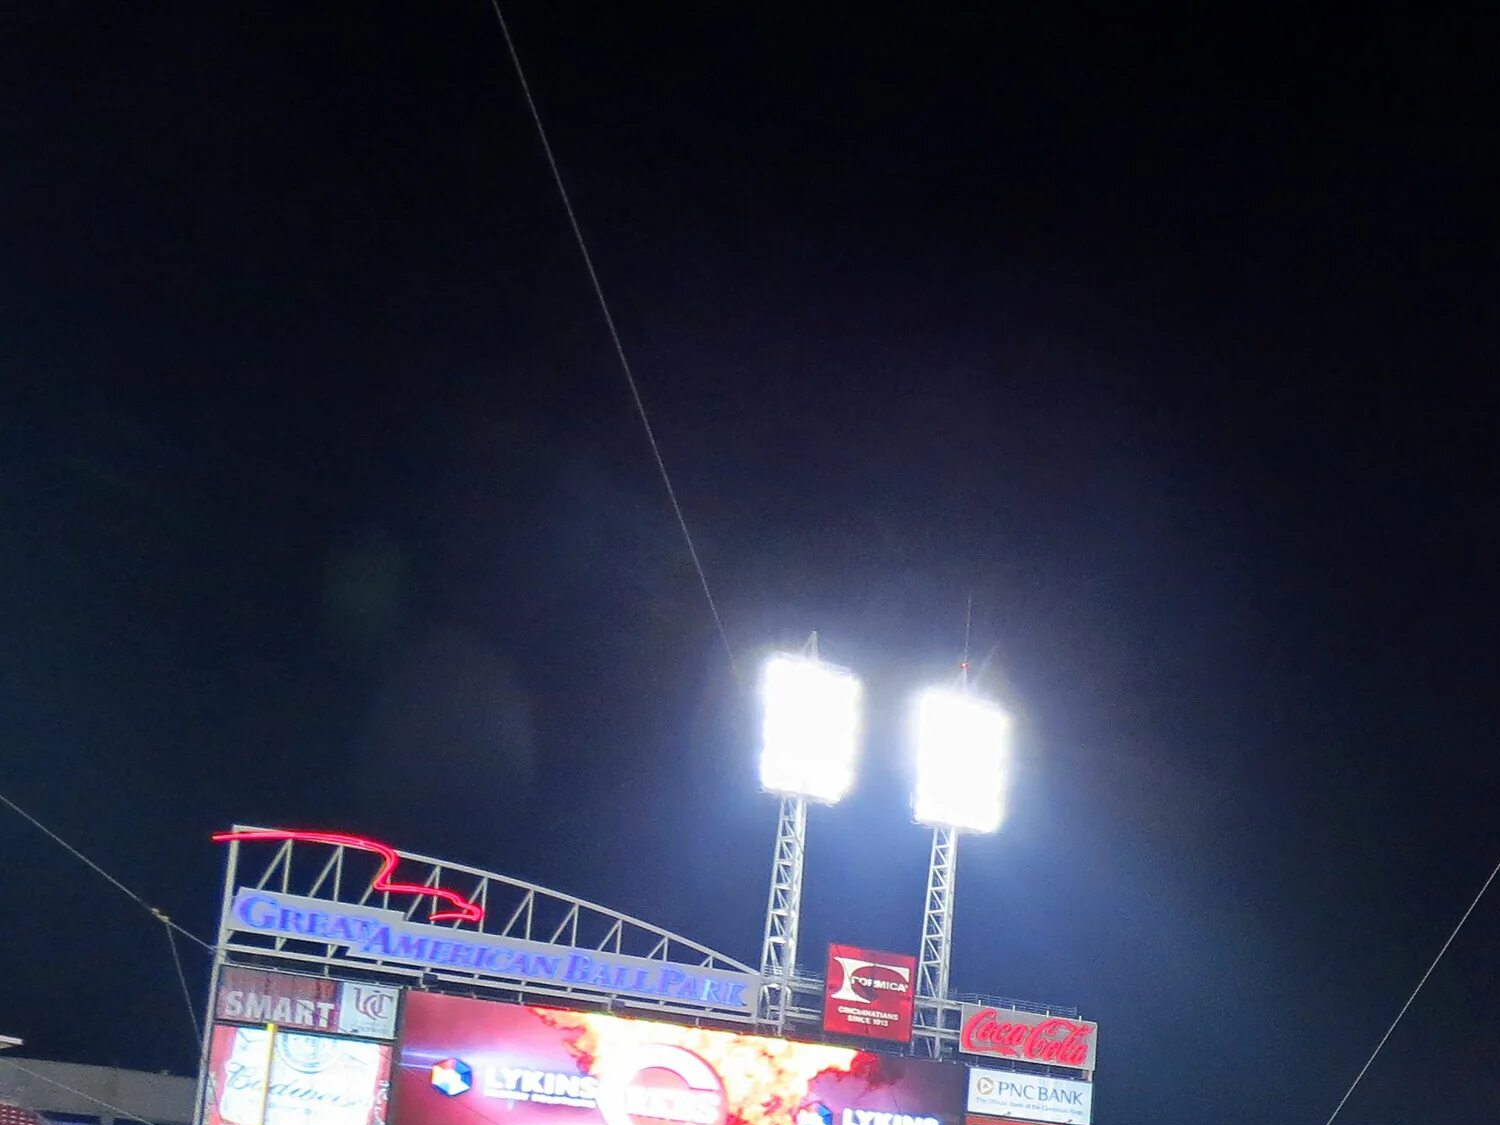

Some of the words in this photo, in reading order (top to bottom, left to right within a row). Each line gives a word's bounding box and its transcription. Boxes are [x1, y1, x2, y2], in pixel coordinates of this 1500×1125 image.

[232, 895, 375, 943] GREAT
[361, 926, 560, 981] AMERICAN
[560, 953, 657, 994] BALL
[655, 966, 750, 1007] PARK
[224, 990, 335, 1028] SMART
[838, 1005, 899, 1021] CINCINNATIANS
[847, 1014, 872, 1025] SINCE
[484, 1066, 598, 1098] LYKINS
[998, 1081, 1035, 1100] PNC
[1038, 1087, 1083, 1106] BANK
